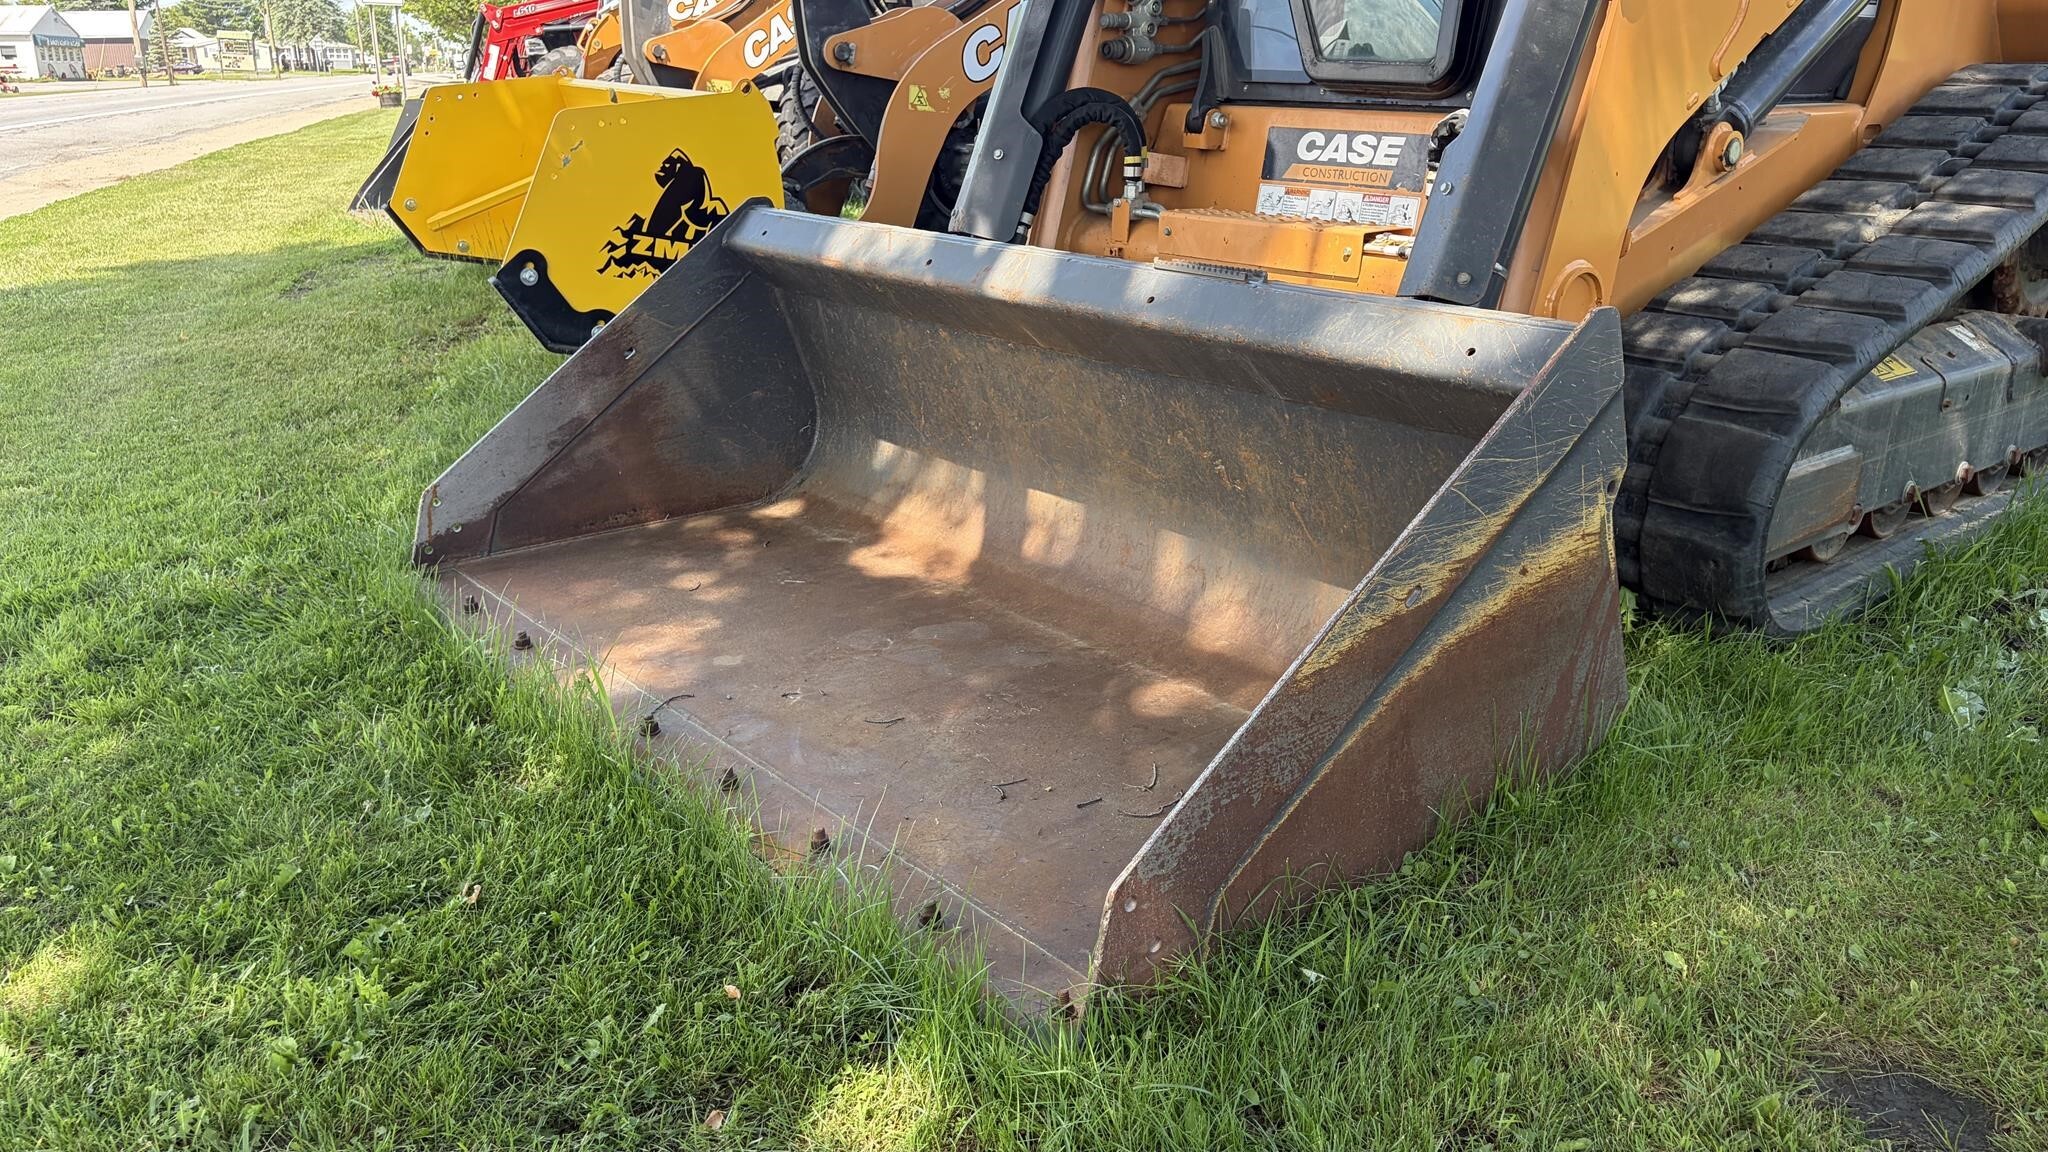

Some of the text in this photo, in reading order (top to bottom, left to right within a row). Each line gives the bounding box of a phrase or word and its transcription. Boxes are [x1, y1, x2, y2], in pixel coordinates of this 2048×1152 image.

[1296, 131, 1407, 167] CASE
[1302, 167, 1389, 184] CONSTRUCTION
[1369, 195, 1390, 204] DANGER
[631, 234, 692, 261] ZM
